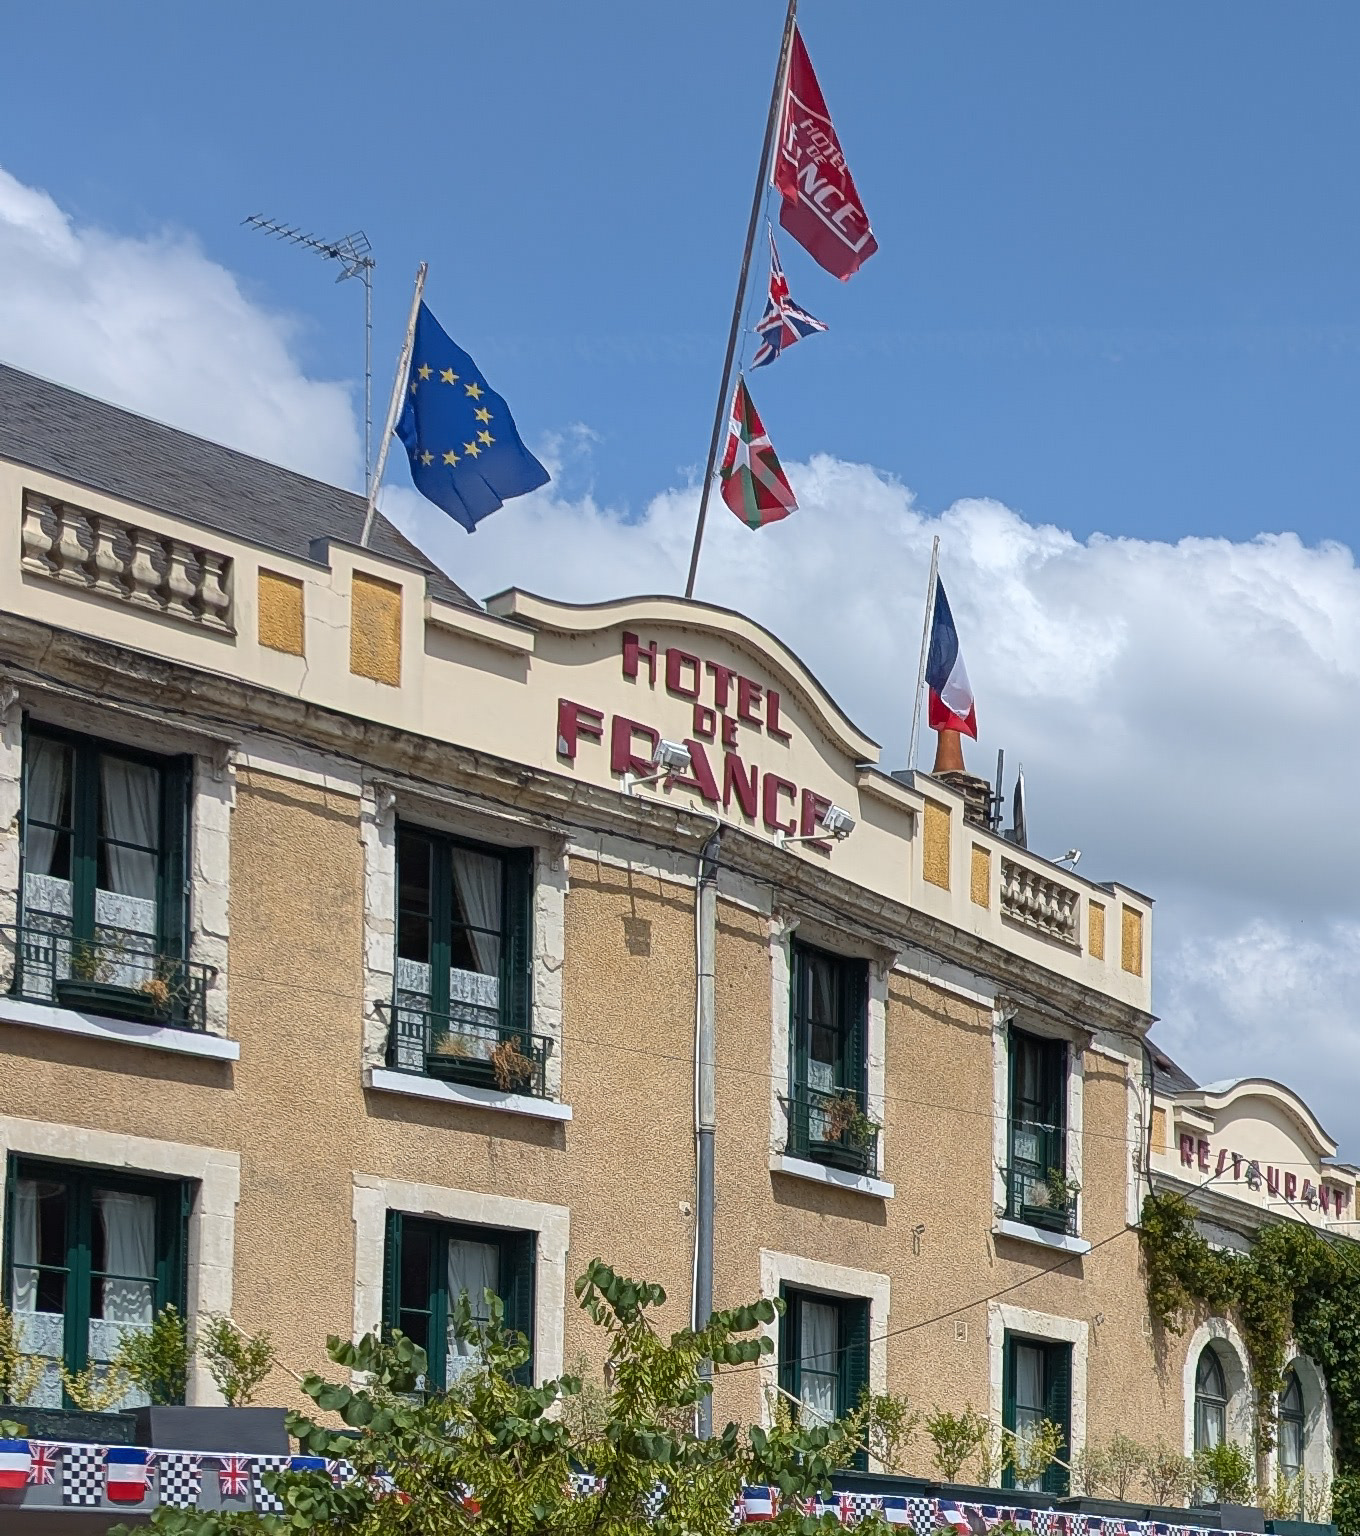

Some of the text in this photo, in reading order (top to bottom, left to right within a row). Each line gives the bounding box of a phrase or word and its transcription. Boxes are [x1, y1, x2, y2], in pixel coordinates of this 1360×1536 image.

[800, 118, 847, 177] HOTEL
[806, 144, 828, 166] DE
[622, 631, 792, 740] HOTEL
[694, 703, 739, 747] DE
[557, 698, 833, 853] FRANCE
